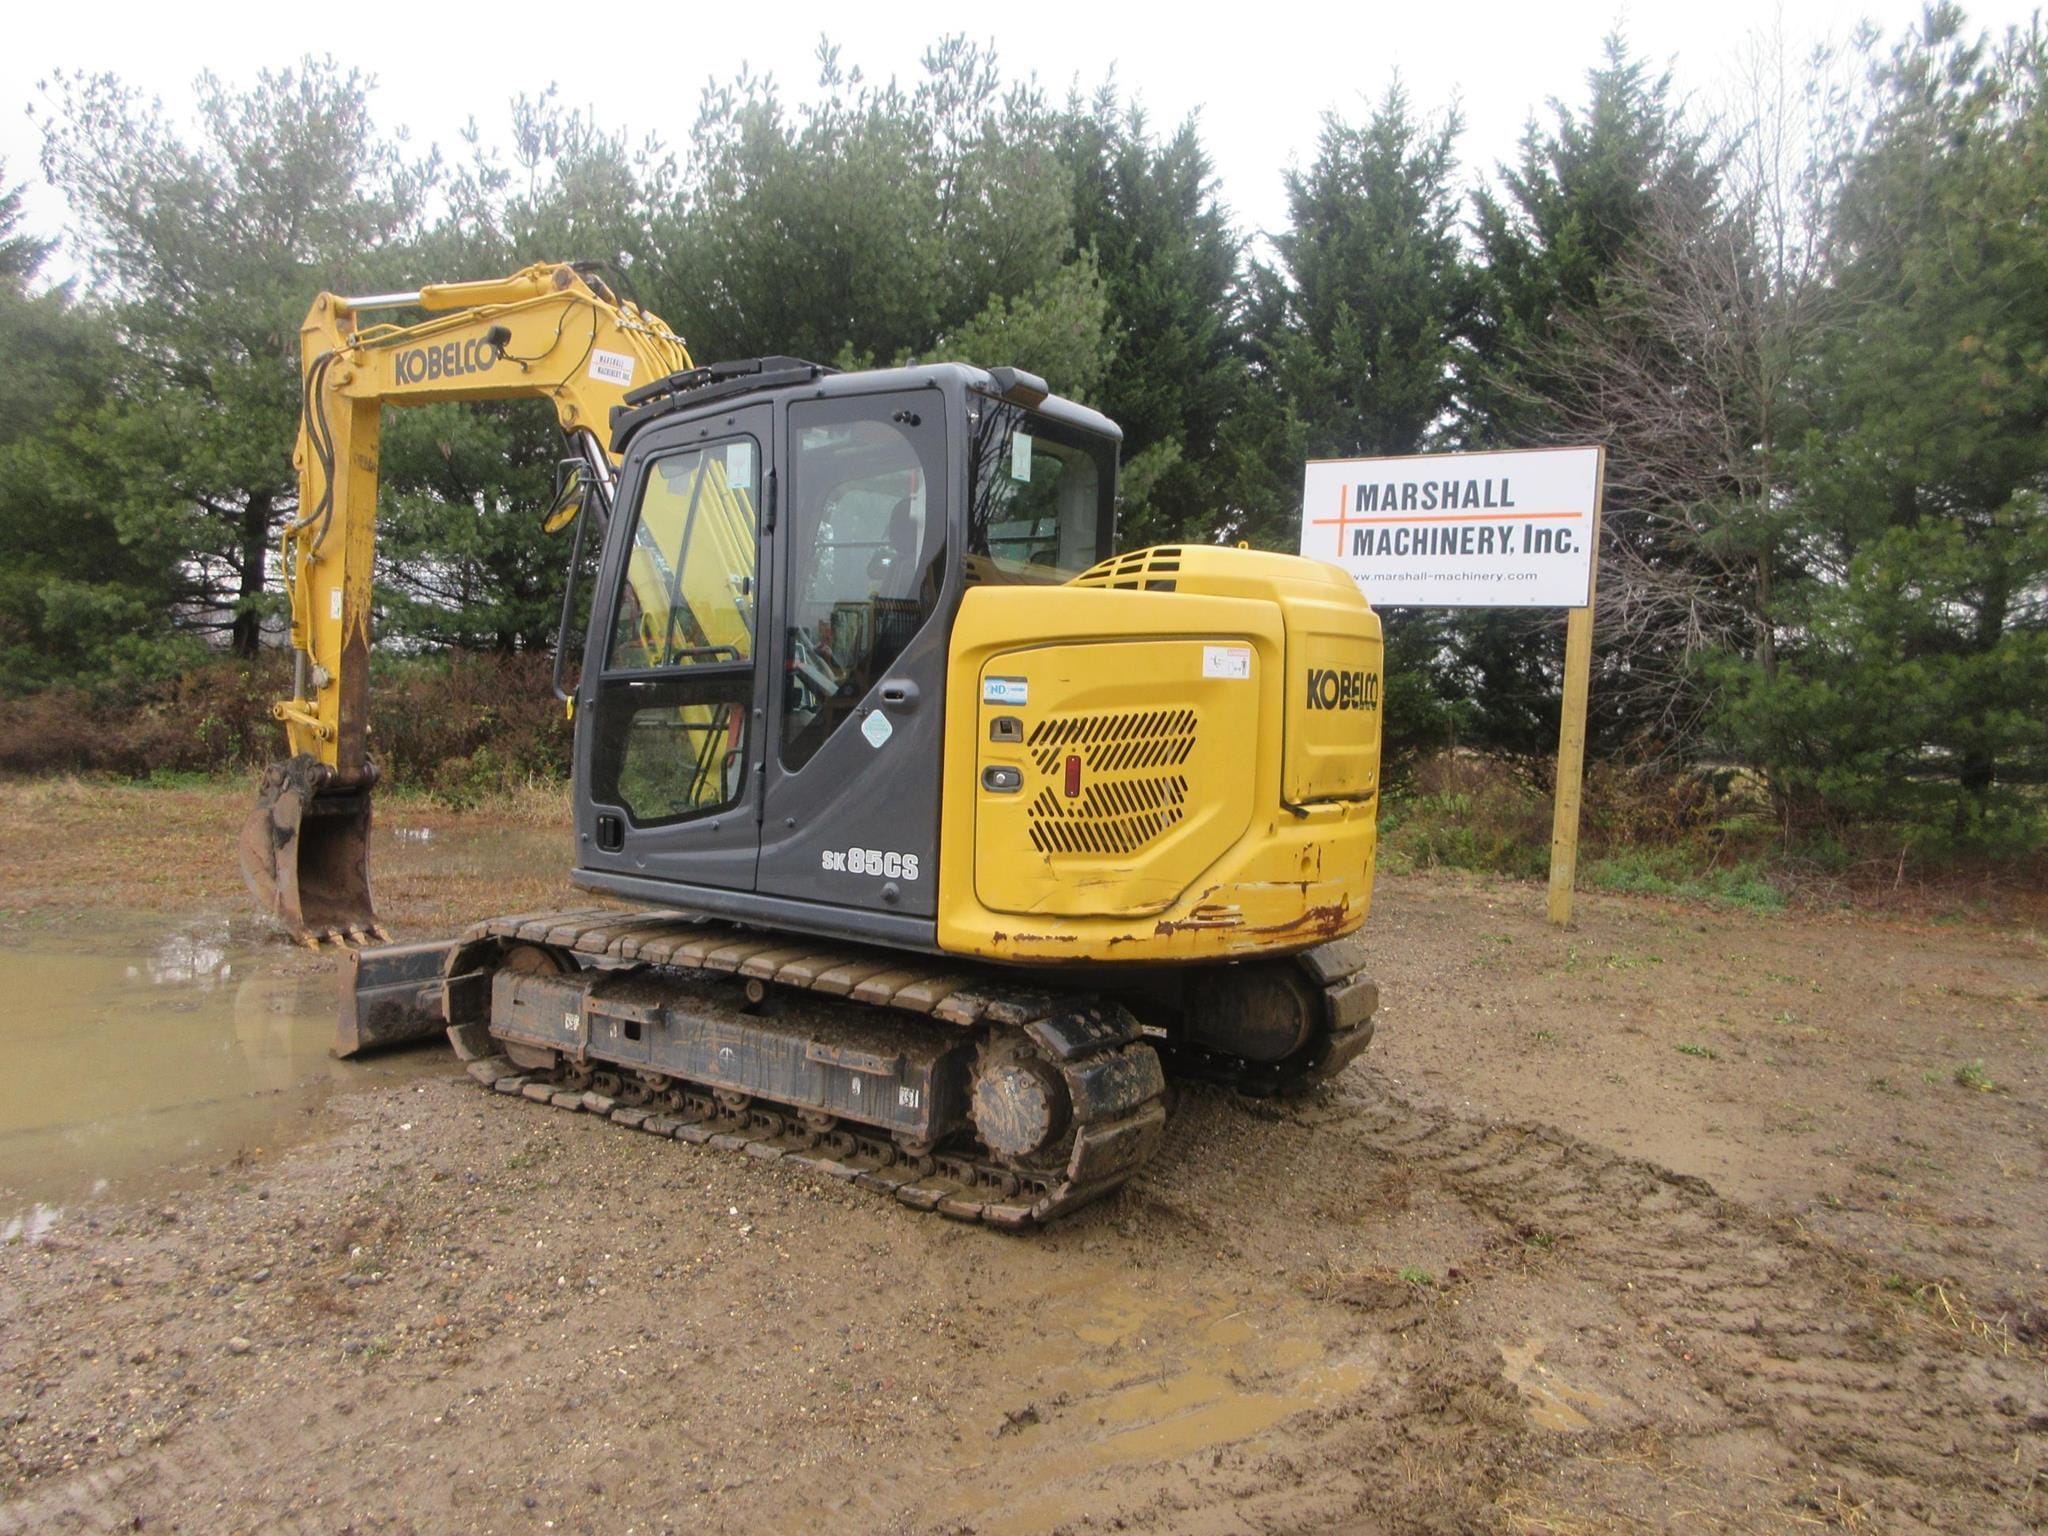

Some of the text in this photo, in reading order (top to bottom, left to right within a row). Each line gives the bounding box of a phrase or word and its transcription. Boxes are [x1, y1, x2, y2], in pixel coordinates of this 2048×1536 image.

[395, 336, 498, 386] KOBELCO
[1355, 478, 1515, 512] MARSHALL
[1352, 523, 1580, 557] MACHINERY, Inc.
[1306, 668, 1378, 711] KOBELCO
